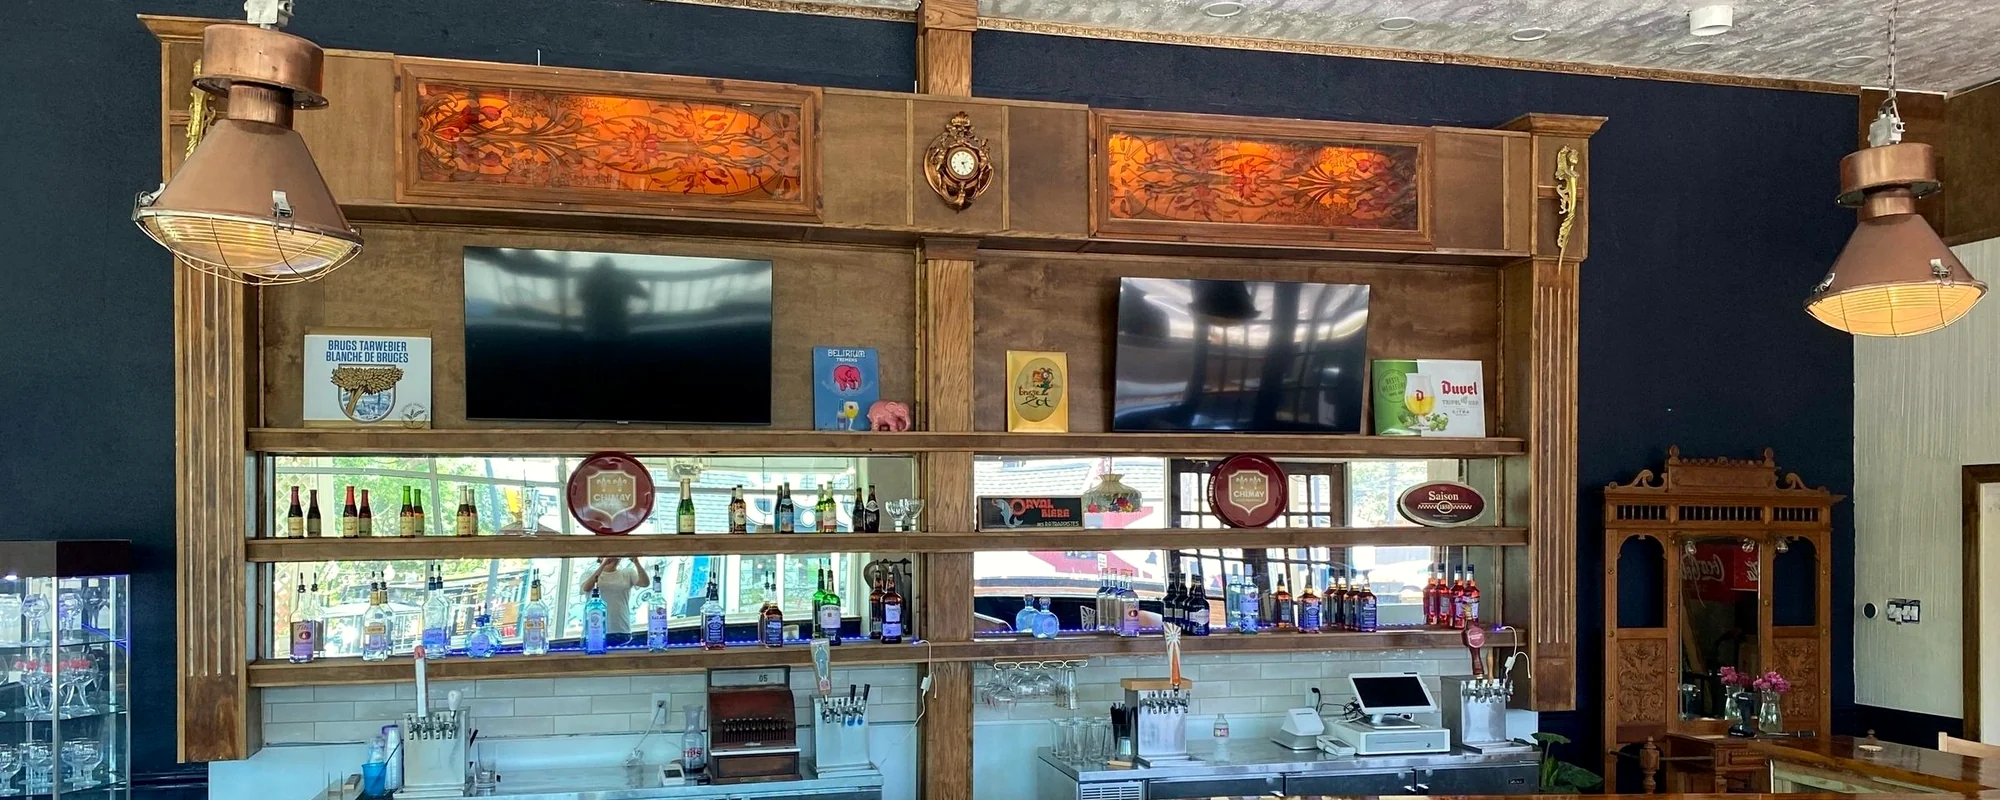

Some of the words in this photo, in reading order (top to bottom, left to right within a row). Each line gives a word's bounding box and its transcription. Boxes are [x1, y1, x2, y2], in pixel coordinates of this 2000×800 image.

[328, 340, 357, 350] BRUGS
[359, 341, 407, 351] TARWEBIER
[326, 352, 362, 361] BLANCHE
[365, 352, 374, 361] DE
[376, 353, 409, 363] BRUGES
[1441, 380, 1477, 395] Duvel
[593, 493, 632, 501] CHIMAY
[1233, 490, 1265, 498] CHIMAY
[1428, 491, 1459, 500] Saison
